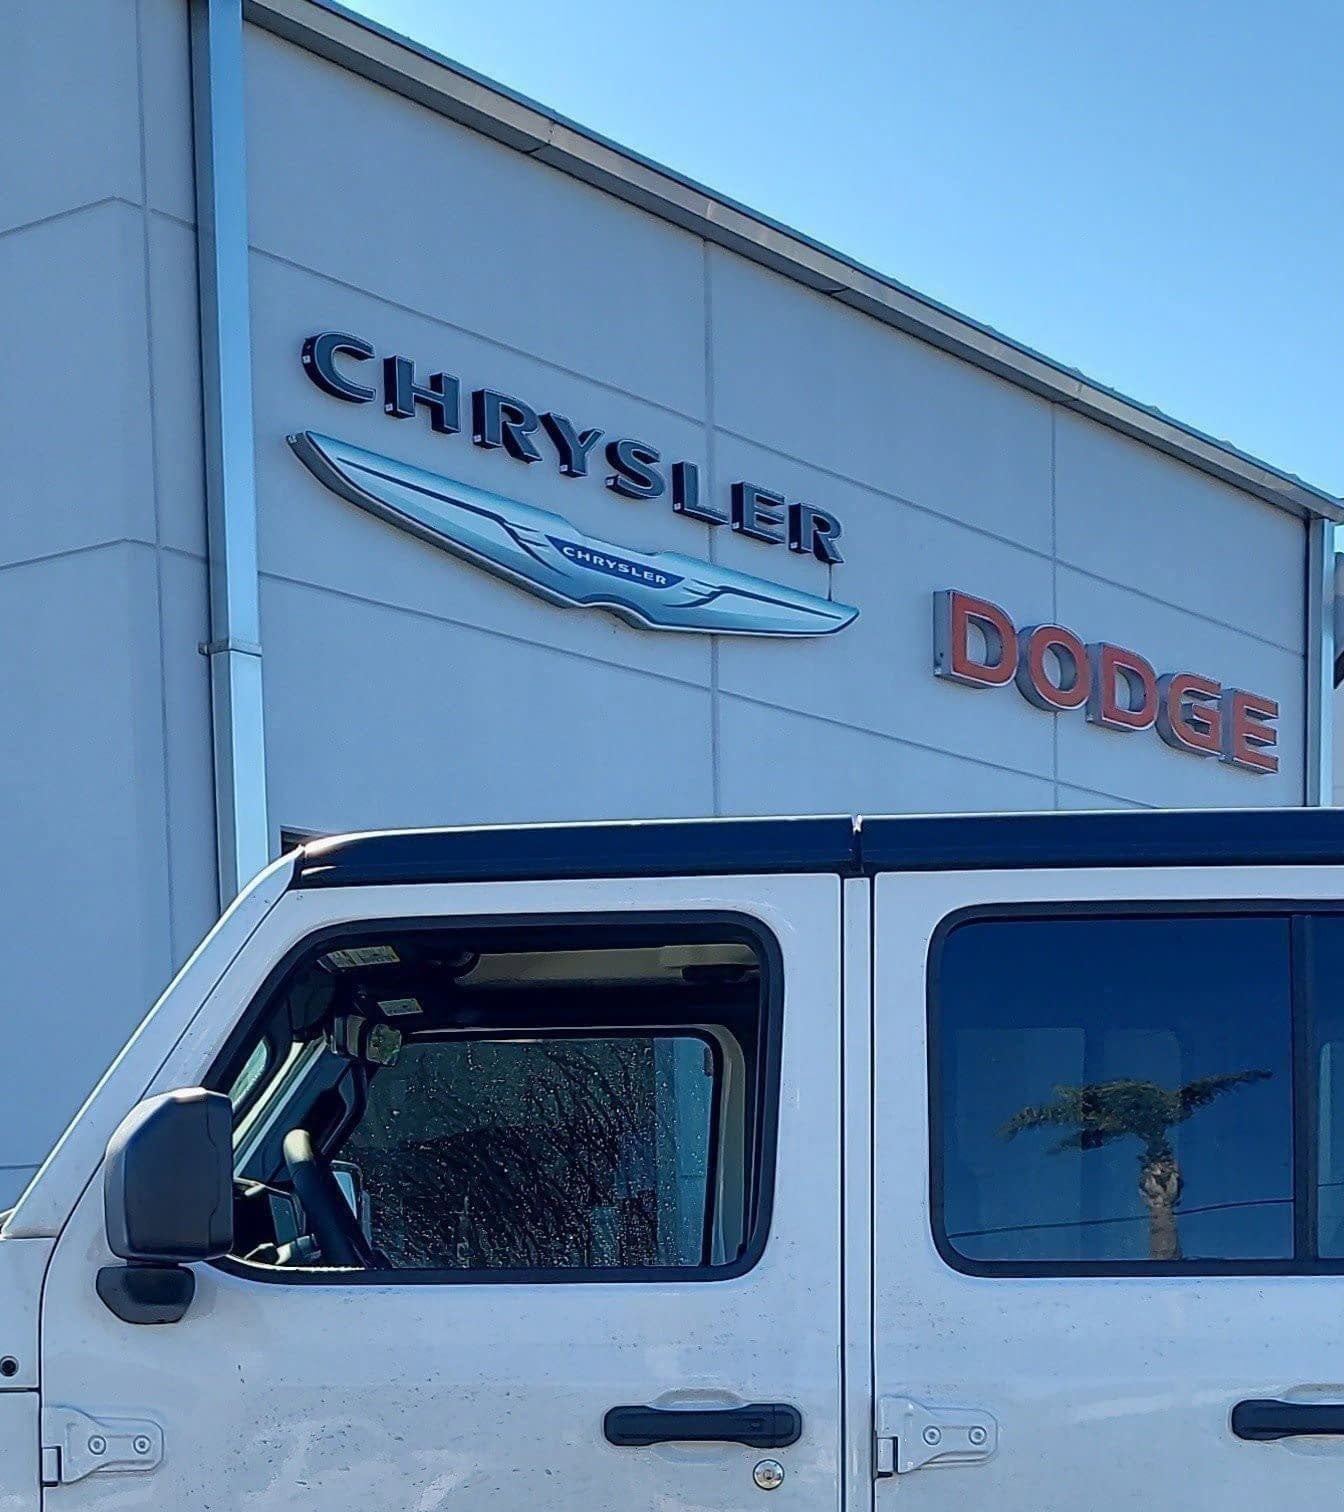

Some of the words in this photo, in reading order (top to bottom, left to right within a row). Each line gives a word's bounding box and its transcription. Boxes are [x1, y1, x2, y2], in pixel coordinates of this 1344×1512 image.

[302, 331, 844, 563] CHRYSLER
[562, 546, 667, 584] CHRYSLER
[933, 589, 1280, 775] DODGE
